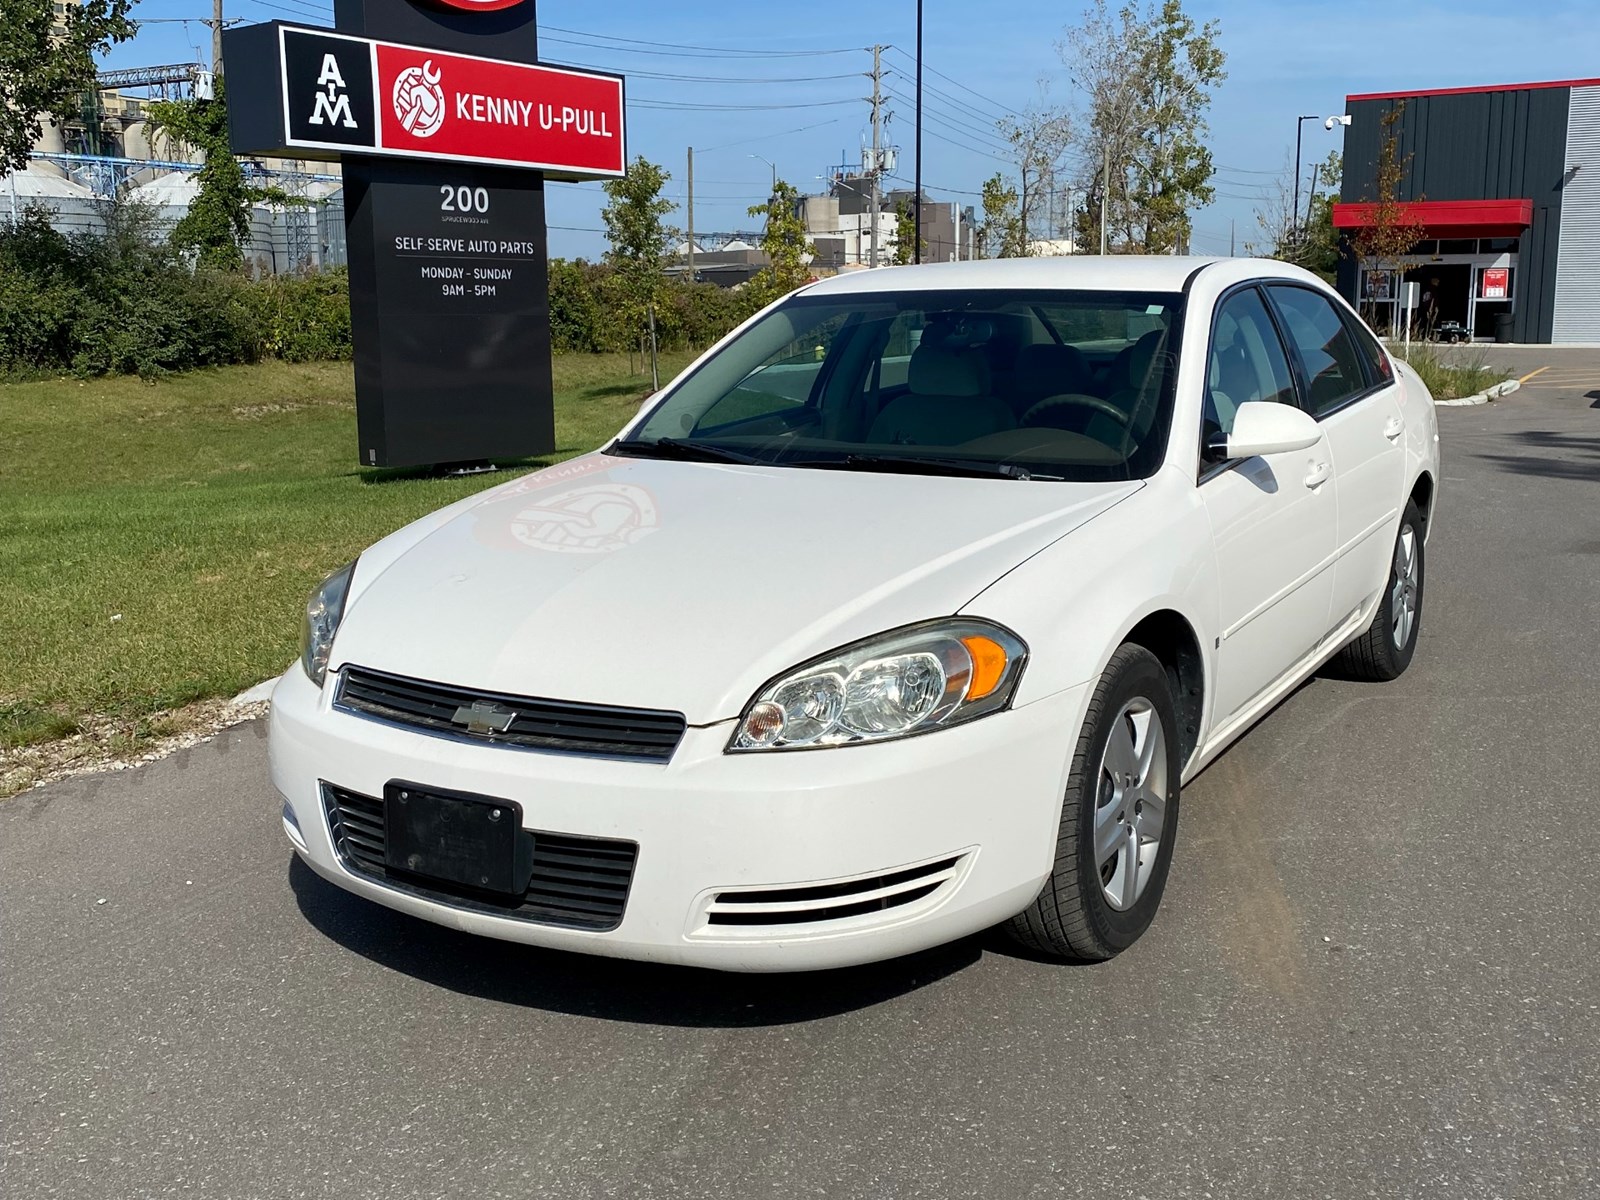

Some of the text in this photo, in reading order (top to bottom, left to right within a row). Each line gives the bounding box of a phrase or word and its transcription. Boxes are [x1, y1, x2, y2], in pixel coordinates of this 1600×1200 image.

[308, 53, 358, 129] AIM
[455, 92, 613, 138] KENNY U-PULL
[440, 184, 489, 213] 200
[394, 236, 534, 255] SELF-SERVE AUTO PARTS
[421, 266, 464, 279] MONDAY
[473, 268, 513, 280] SUNDAY
[442, 284, 464, 296] 9AM
[474, 284, 496, 296] 5PM
